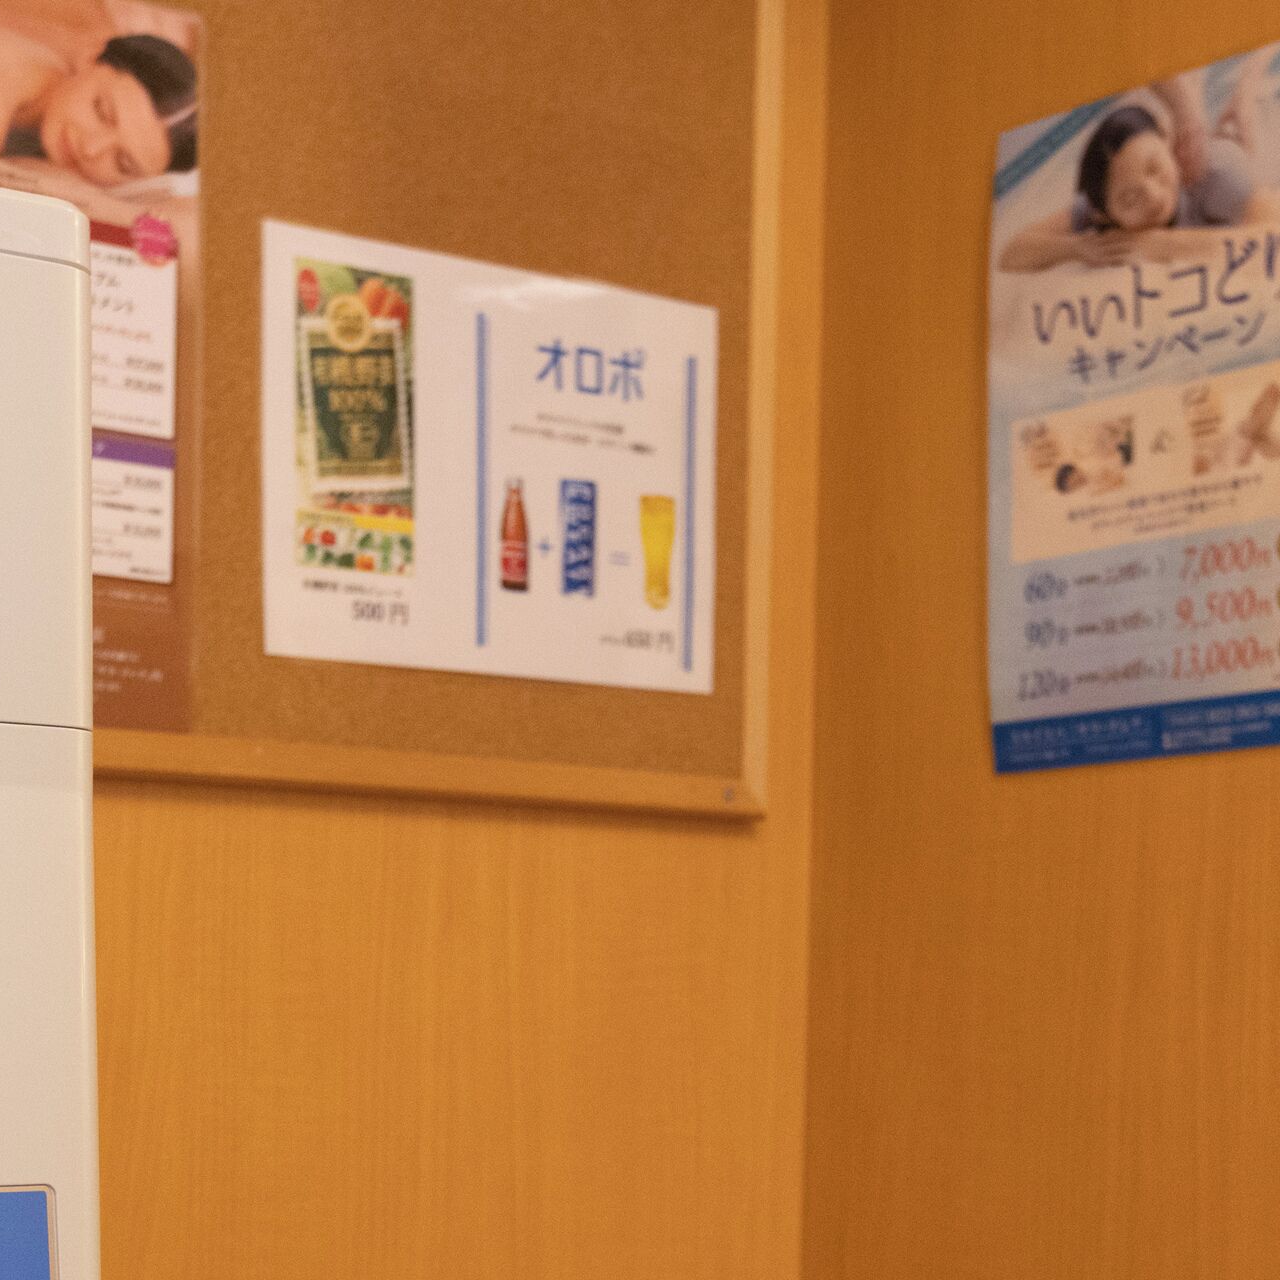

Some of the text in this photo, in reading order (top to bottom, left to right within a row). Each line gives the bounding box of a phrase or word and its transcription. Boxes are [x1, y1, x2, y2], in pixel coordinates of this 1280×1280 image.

[1069, 309, 1267, 384] キャンペーン
